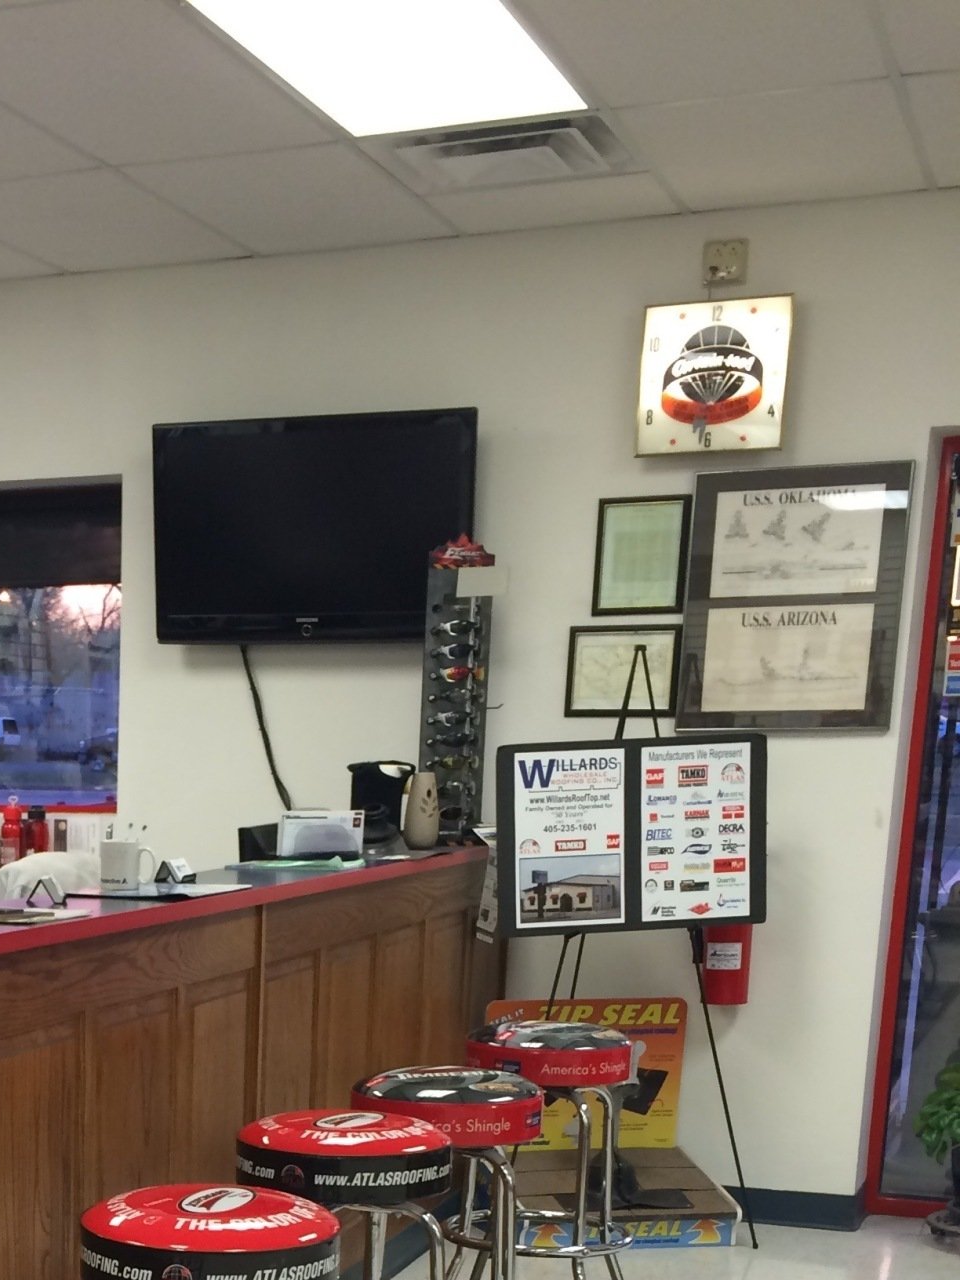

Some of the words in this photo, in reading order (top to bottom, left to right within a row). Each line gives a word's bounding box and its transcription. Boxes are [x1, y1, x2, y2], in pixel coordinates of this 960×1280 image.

[712, 305, 723, 322] 12
[646, 410, 653, 425] 8
[767, 404, 775, 418] 4
[704, 432, 711, 448] 6
[741, 612, 772, 628] U.S.S.
[777, 611, 837, 627] ARIZONA
[649, 751, 695, 761] Manufacturers
[696, 750, 707, 759] We
[710, 749, 742, 760] Represent
[518, 757, 618, 789] WILLARDS
[680, 768, 705, 779] TAMKO
[529, 793, 610, 804] www.WillardsRoofTop.net
[543, 823, 597, 833] 405-235-1601
[718, 824, 745, 833] DECRA
[598, 1003, 681, 1025] SEAL
[541, 1062, 596, 1076] America's
[466, 1117, 511, 1136] Shingle
[625, 1220, 682, 1237] SEAL
